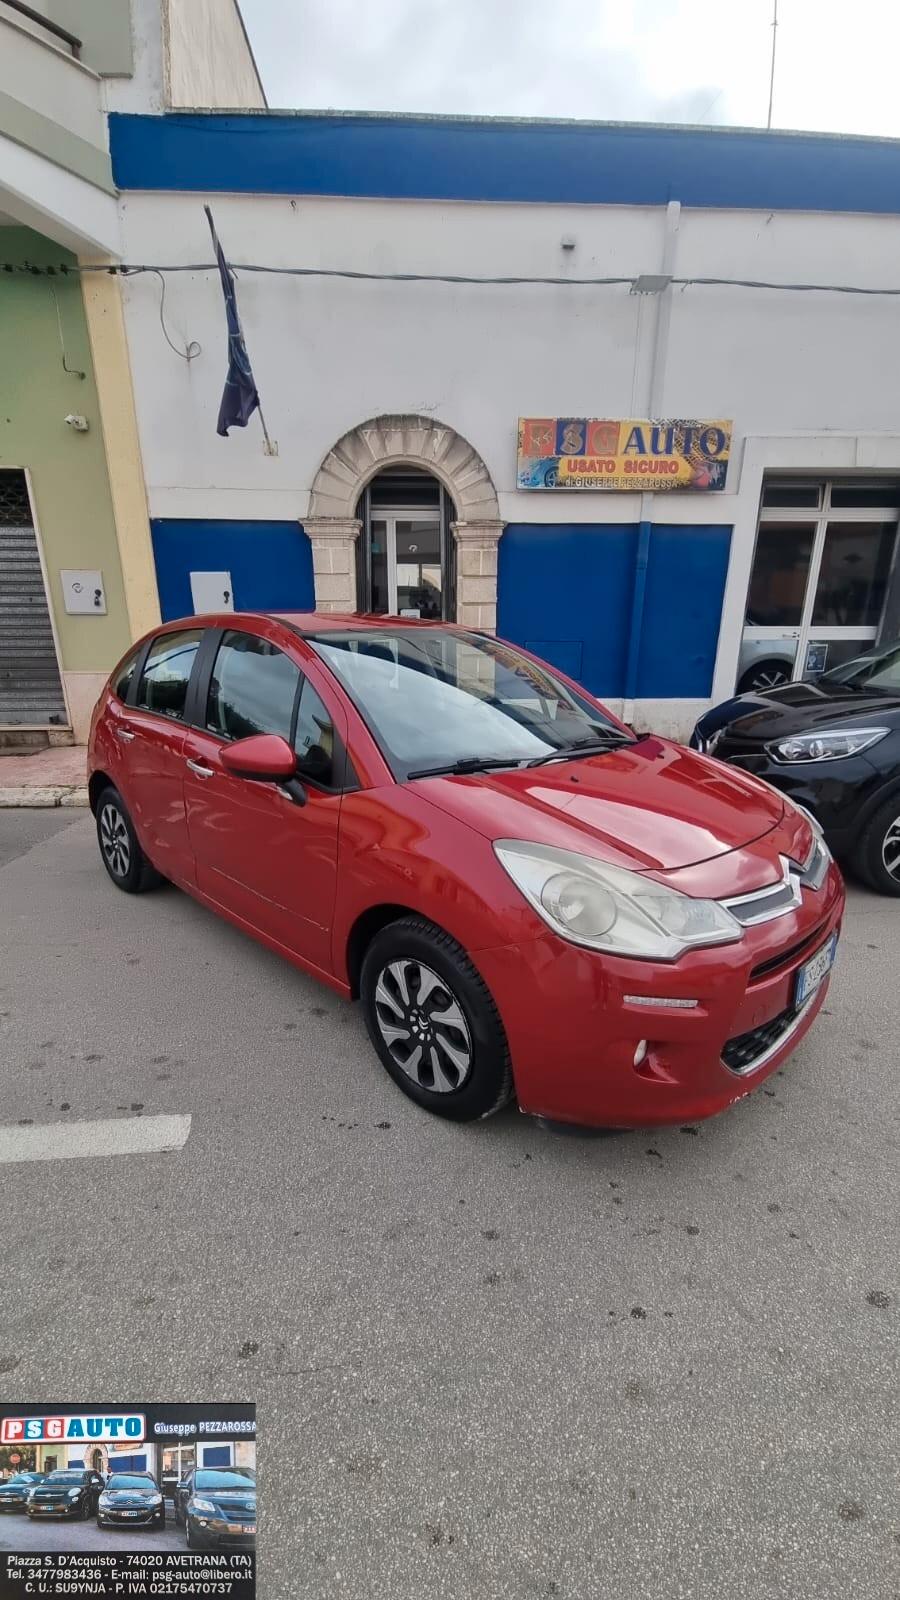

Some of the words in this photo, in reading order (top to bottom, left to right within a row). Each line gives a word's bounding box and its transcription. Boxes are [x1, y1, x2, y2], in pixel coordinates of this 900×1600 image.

[622, 426, 725, 455] AUTO
[567, 459, 615, 474] USATO
[624, 460, 679, 474] SICURO
